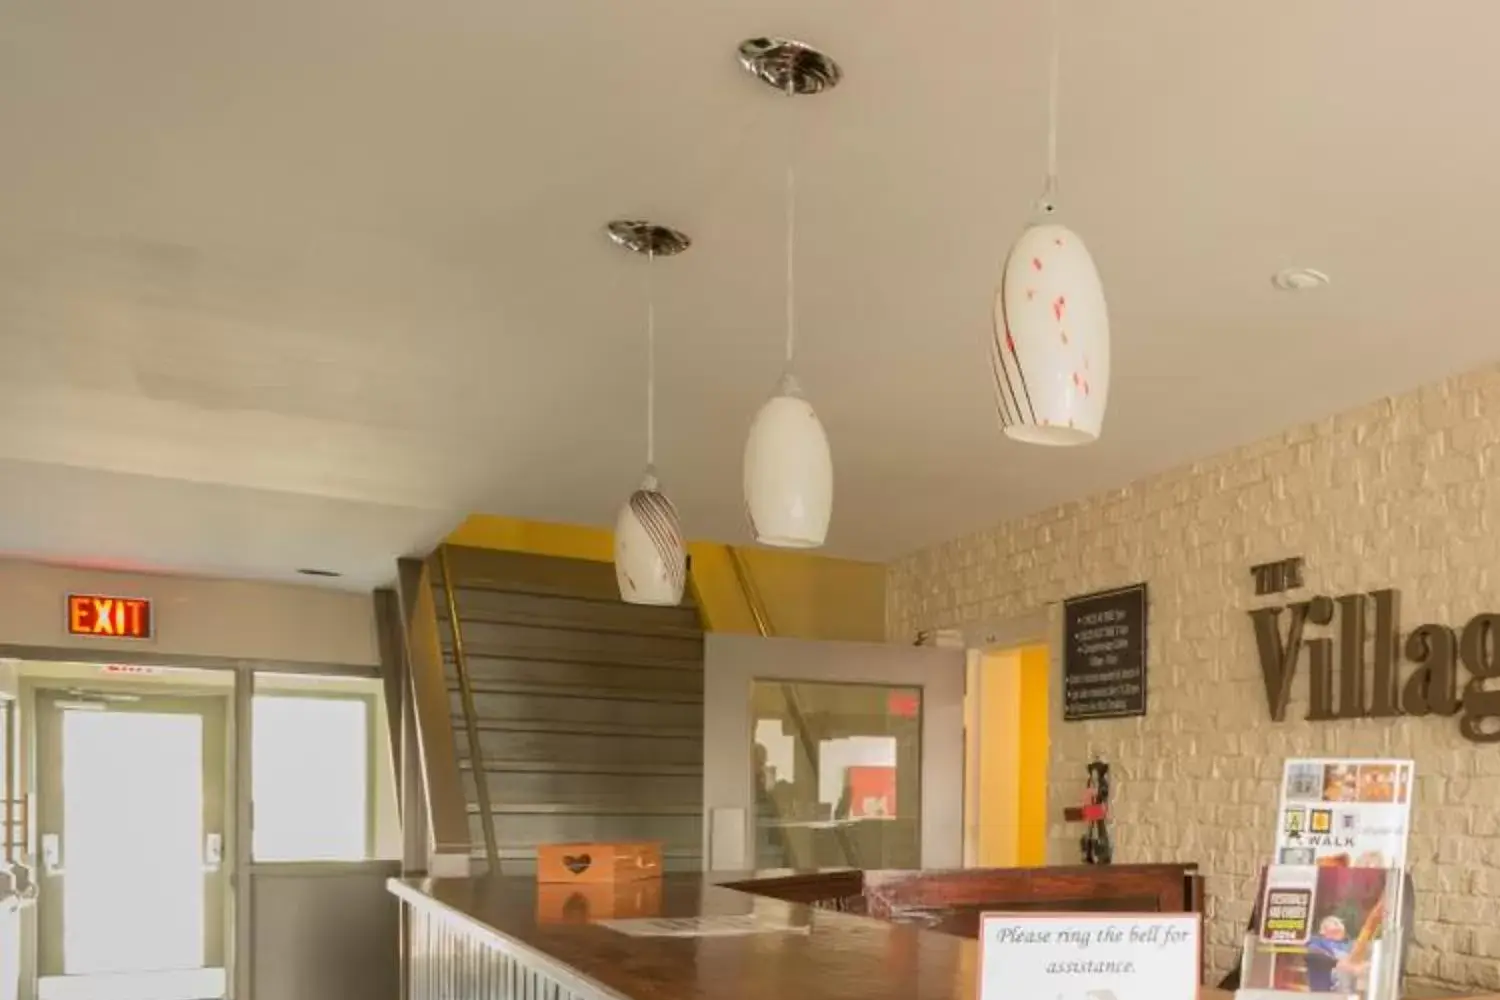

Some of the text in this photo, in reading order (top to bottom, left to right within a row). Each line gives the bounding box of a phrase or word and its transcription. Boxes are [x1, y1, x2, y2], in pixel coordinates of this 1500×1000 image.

[1250, 557, 1304, 596] THE
[71, 598, 145, 634] EXIT
[1309, 835, 1355, 848] WALK
[996, 924, 1190, 950] Please ring the bell for
[1045, 960, 1136, 974] assistance.
